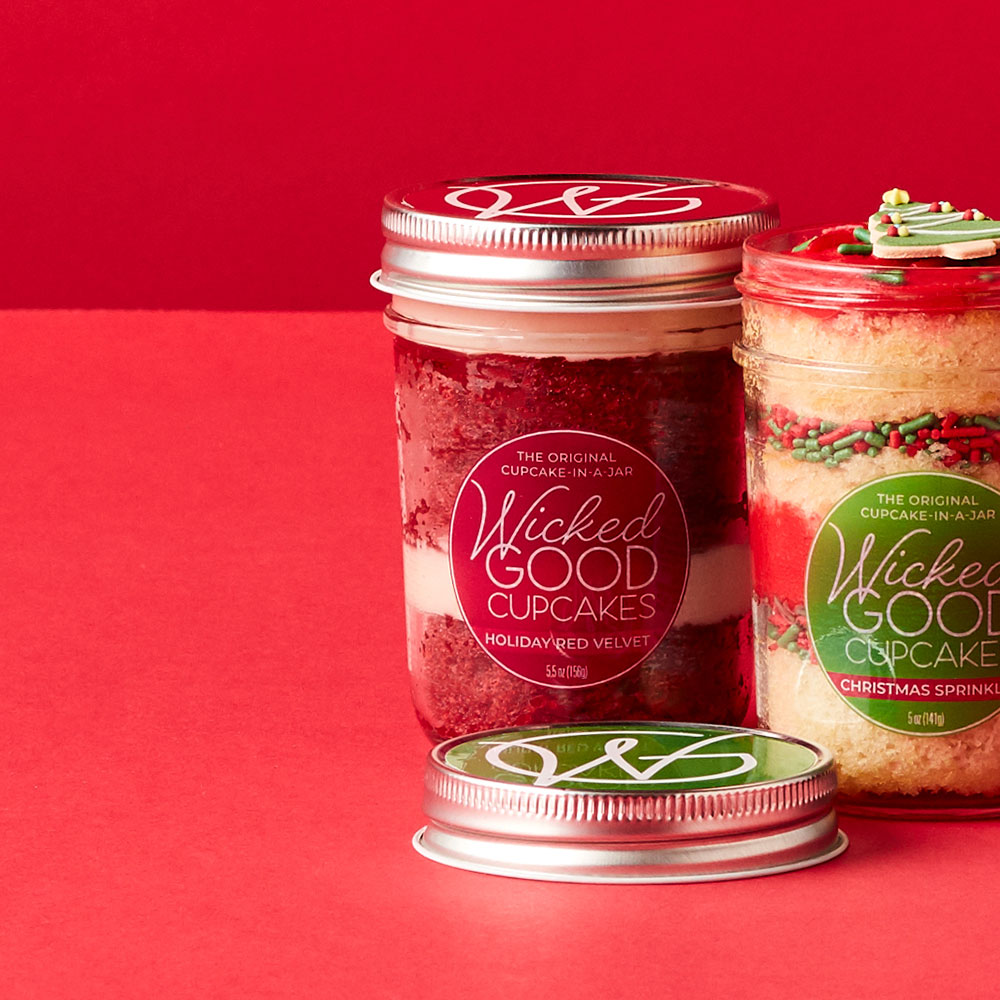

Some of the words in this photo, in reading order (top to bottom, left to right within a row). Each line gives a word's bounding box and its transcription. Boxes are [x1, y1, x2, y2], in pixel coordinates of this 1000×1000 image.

[516, 451, 543, 463] THE
[547, 452, 617, 463] ORIGINAL
[501, 465, 633, 478] CUPCAKE-IN-A-JAR
[876, 493, 904, 506] THE
[908, 495, 979, 507] ORIGINAL
[470, 479, 666, 561] Wicked
[860, 508, 996, 521] CUPCAKE-IN-A-JAR
[485, 543, 658, 592] GOOD
[487, 592, 656, 622] CUPCAKES
[485, 632, 551, 649] HOLIDAY
[556, 637, 589, 650] RED
[593, 635, 651, 649] VELVET
[557, 667, 566, 678] oz
[840, 678, 931, 697] CHRISTMAS
[907, 711, 913, 725] 5
[913, 714, 922, 725] oz
